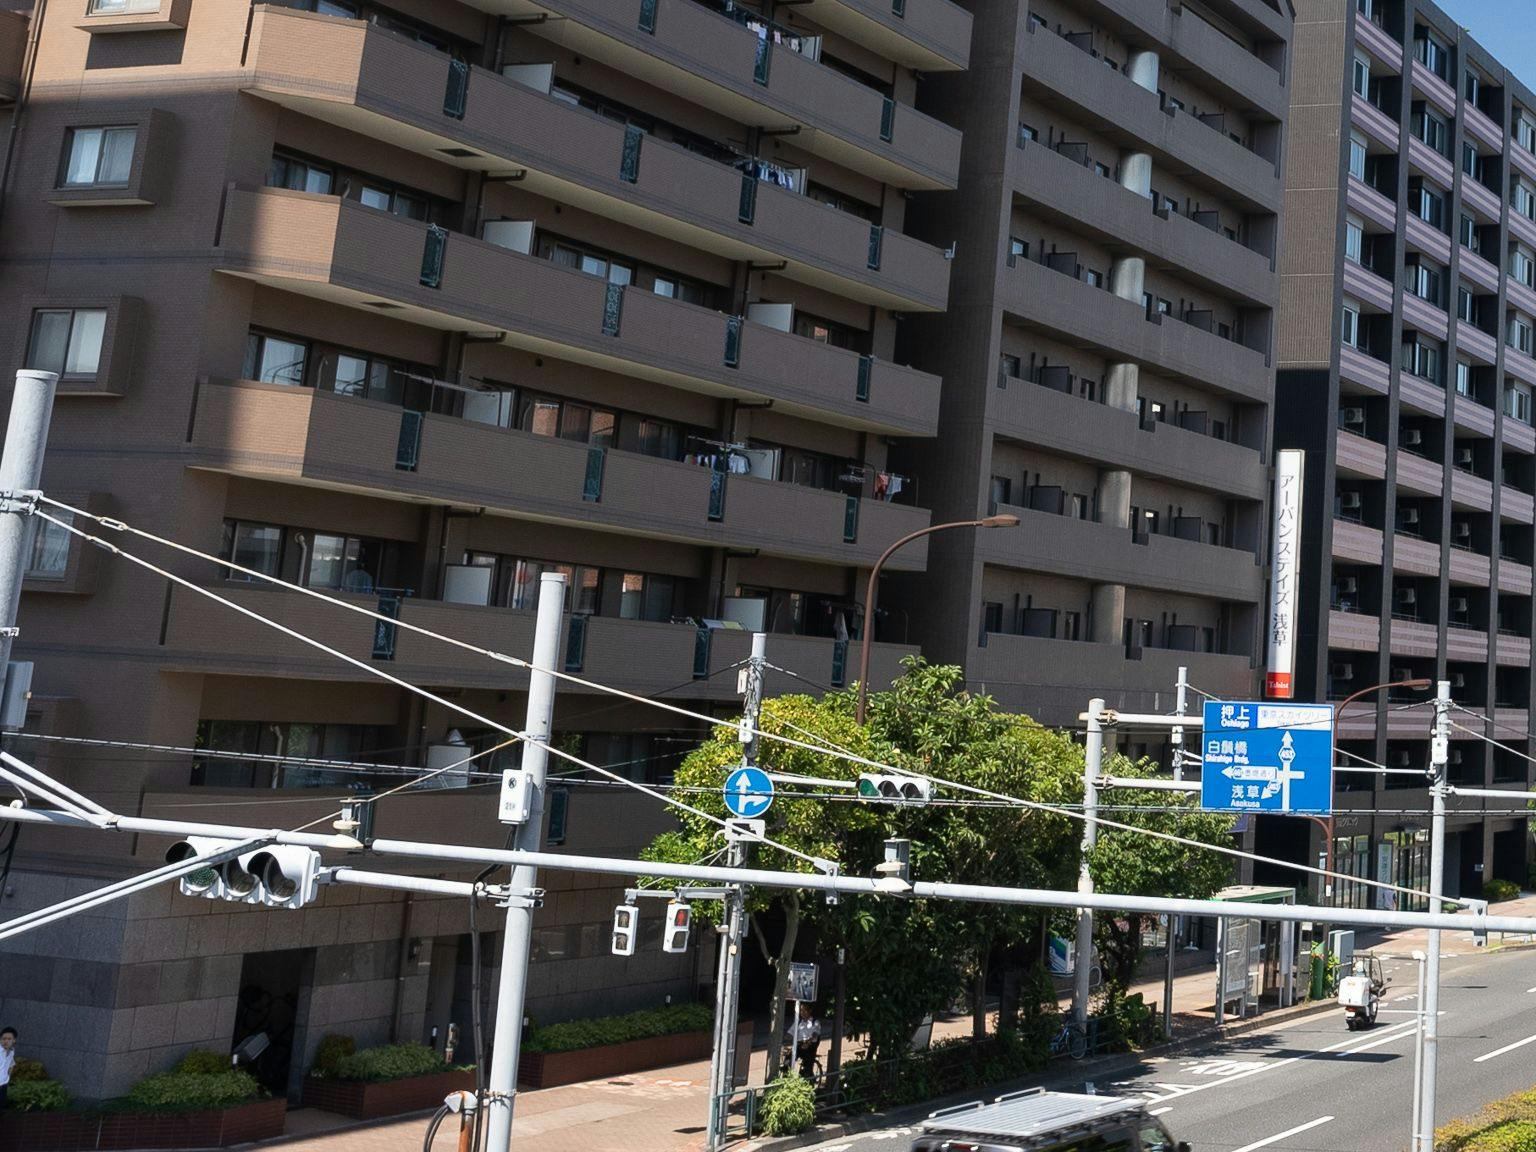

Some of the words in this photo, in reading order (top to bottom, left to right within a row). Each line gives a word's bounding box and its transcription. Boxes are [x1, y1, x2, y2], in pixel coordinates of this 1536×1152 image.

[1275, 474, 1294, 606] アーバンステイズ
[1272, 613, 1288, 646] 浅草
[1221, 704, 1250, 720] 押上
[1221, 719, 1250, 729] Oshiage
[1231, 784, 1260, 799] 浅草
[1230, 799, 1261, 809] Asakusa
